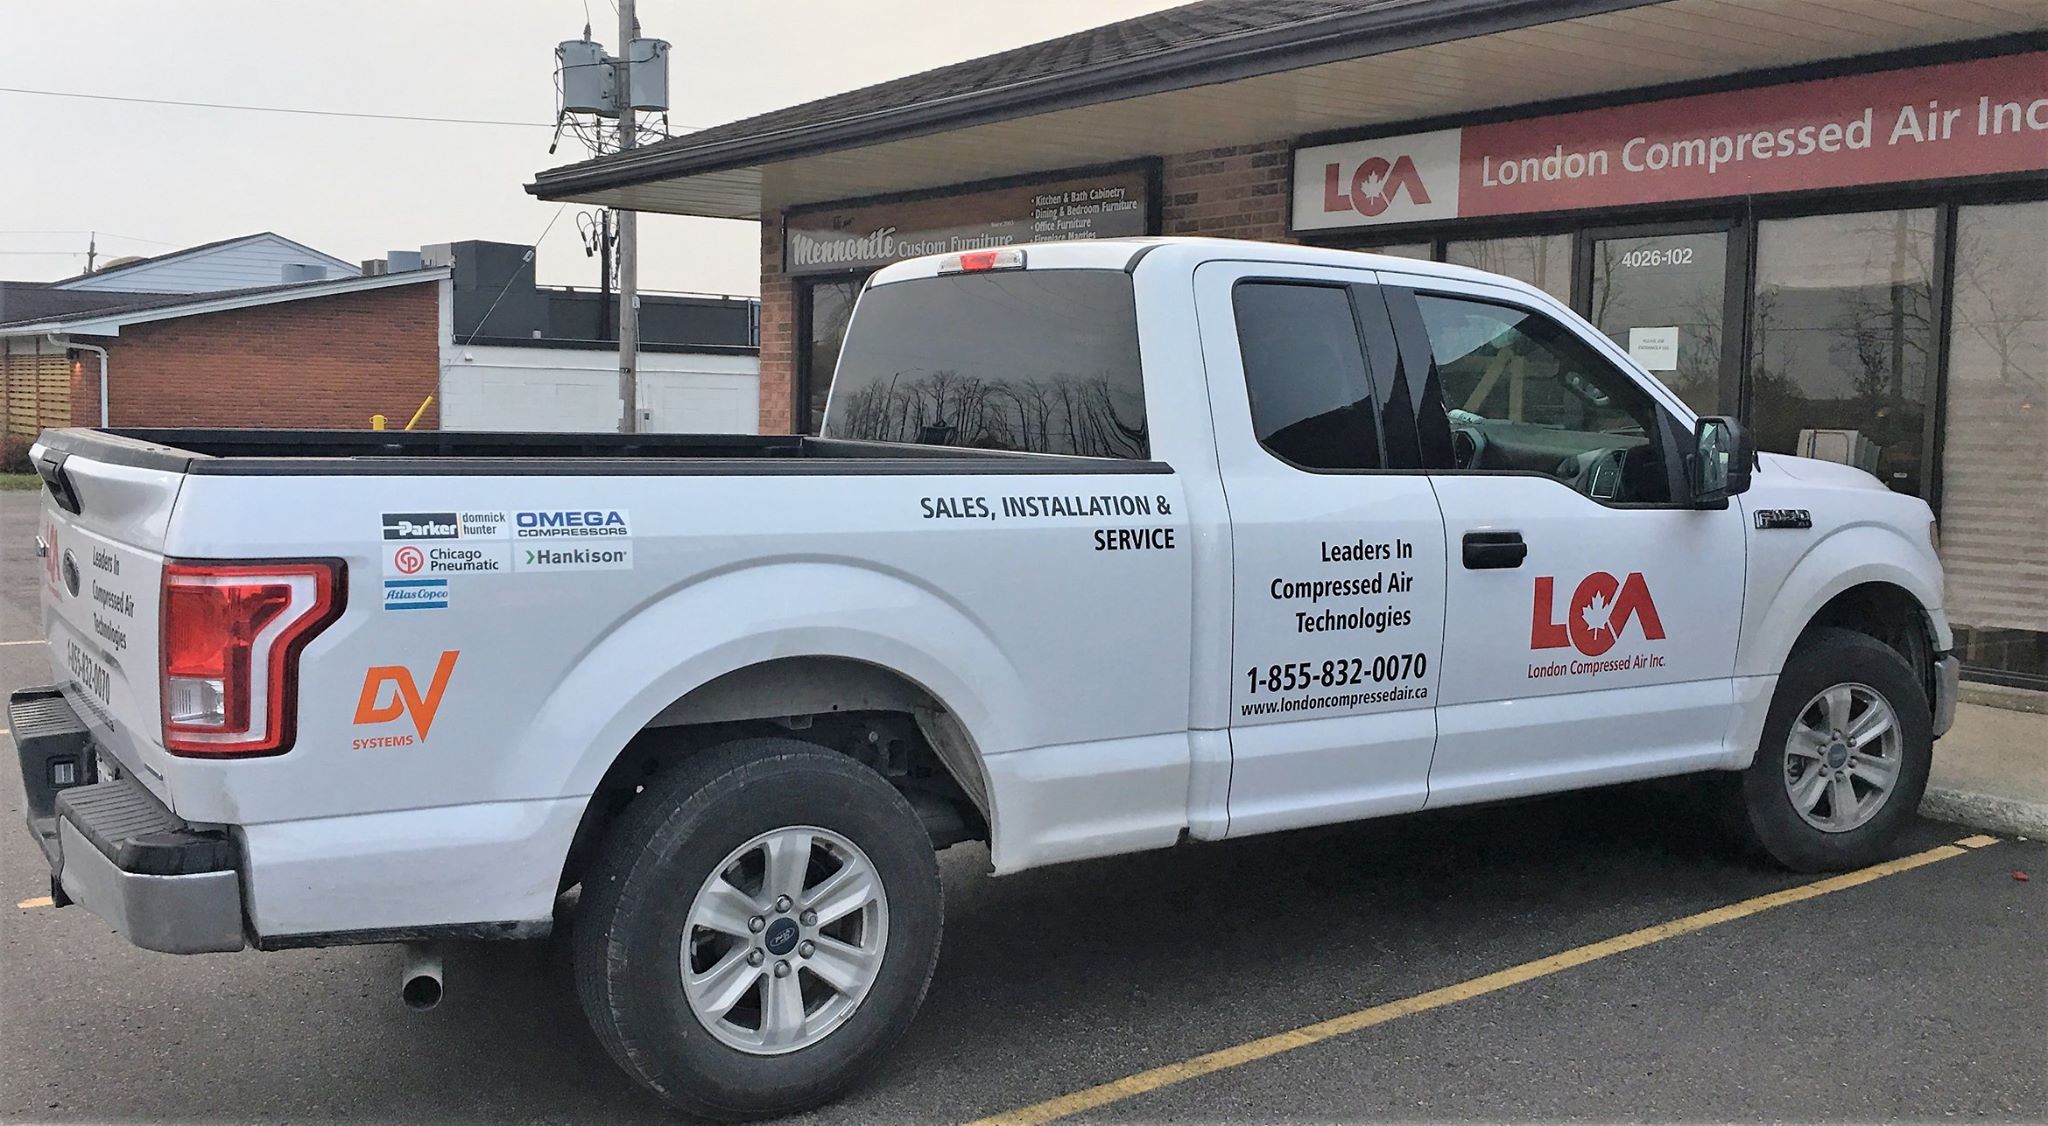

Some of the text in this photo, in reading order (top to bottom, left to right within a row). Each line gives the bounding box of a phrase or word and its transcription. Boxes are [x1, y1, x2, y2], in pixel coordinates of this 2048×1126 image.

[1482, 145, 1608, 187] London
[1622, 107, 1873, 173] Compressed
[1888, 101, 1961, 146] Air
[1035, 187, 1125, 206] Kitchen & Bath Cabinetry
[1324, 155, 1432, 217] LCA
[1035, 200, 1137, 220] Dining & Bedroom Furniture
[1035, 217, 1091, 232] Office Furniture
[792, 226, 1013, 266] Mennonite Custom Furniture
[1622, 248, 1693, 267] 4026-102
[462, 512, 506, 523] domnick
[516, 511, 625, 528] OMEGA
[920, 495, 1172, 521] SALES, INSTALLATION &
[398, 521, 457, 536] Parker
[464, 524, 497, 535] hunter
[518, 527, 628, 537] COMPRESSORS
[1094, 528, 1176, 551] SERVICE
[92, 546, 120, 576] Leaders In
[430, 548, 482, 562] Chicago
[537, 549, 624, 565] Hankison
[1321, 539, 1413, 563] Leaders In
[430, 559, 499, 571] Pneumatic
[92, 579, 124, 613] Compressed
[124, 594, 135, 618] Air
[386, 589, 448, 600] Atlas Copco
[1271, 571, 1413, 603] Compressed Air
[1296, 605, 1411, 633] Technologies
[1531, 571, 1666, 657] LCA
[93, 612, 127, 651] Technologies
[1247, 653, 1427, 693] 1-855-832-0070
[1528, 653, 1666, 678] London Compressed Air Inc.
[352, 650, 460, 744] DV
[1241, 686, 1428, 716] www.londoncompressedair.ca
[352, 735, 414, 750] SYSTEMS
